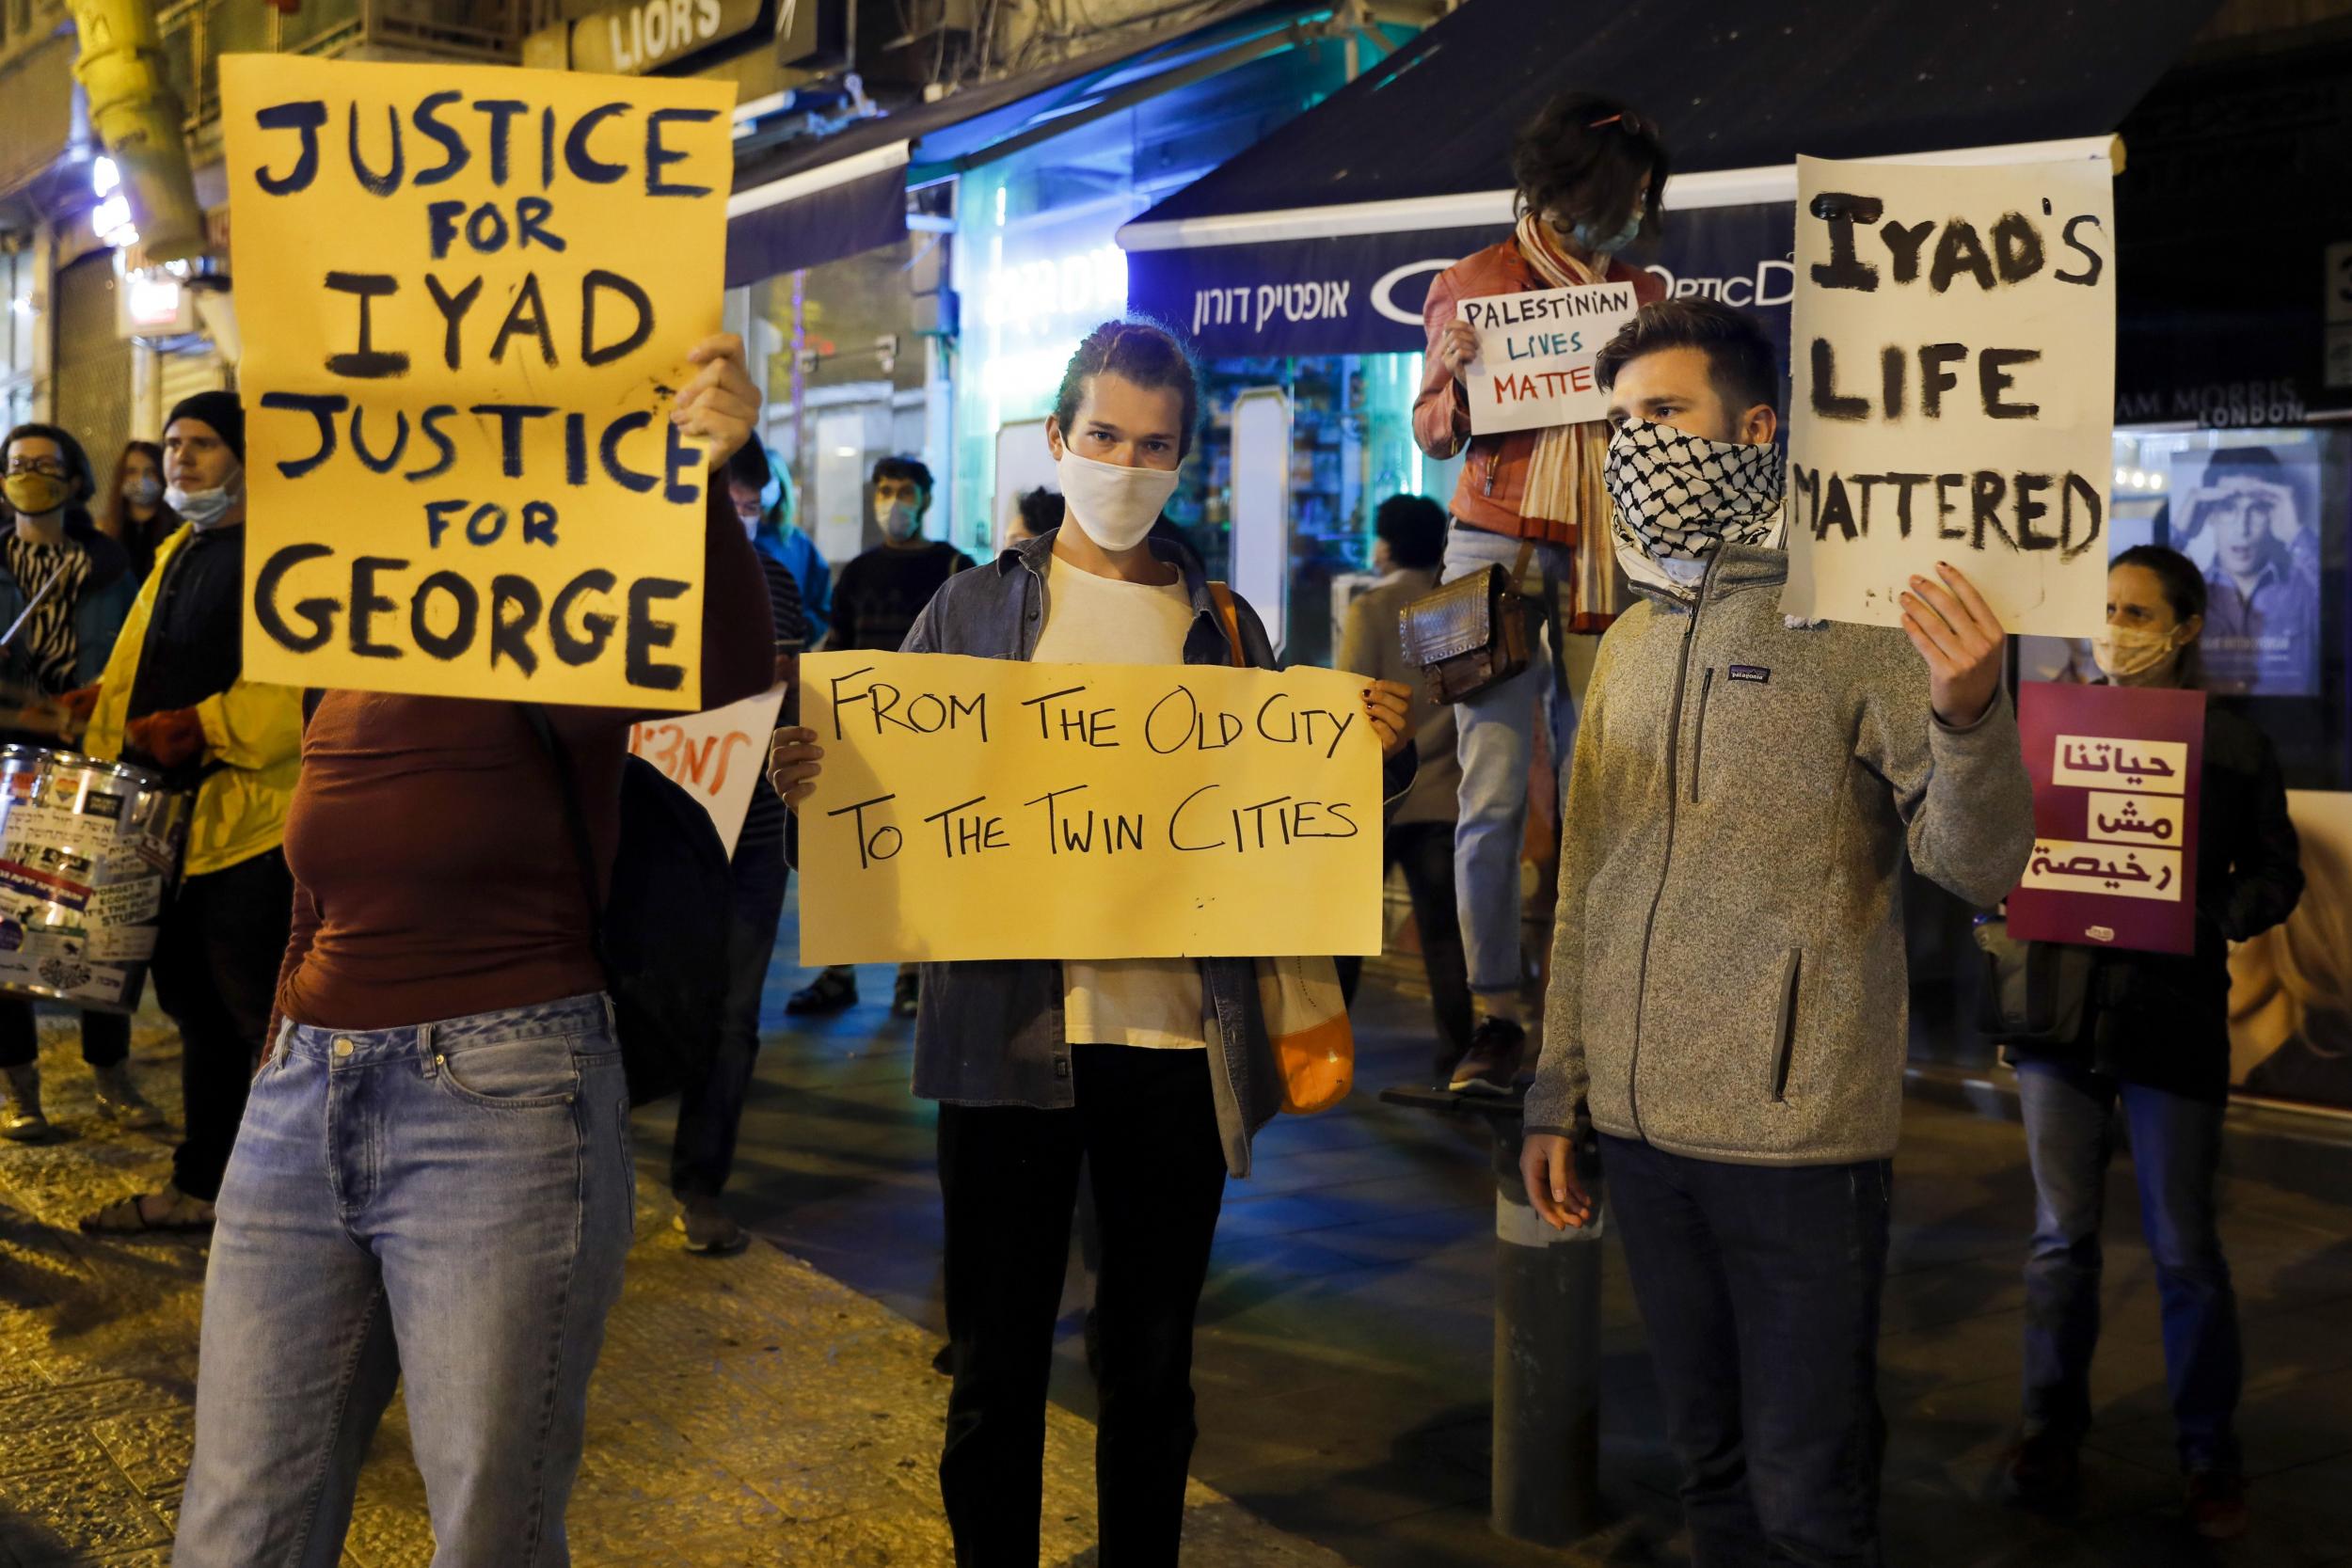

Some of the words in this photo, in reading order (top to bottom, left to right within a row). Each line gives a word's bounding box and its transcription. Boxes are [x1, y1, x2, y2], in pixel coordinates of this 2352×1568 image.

[255, 89, 722, 198] JUSTICE
[427, 196, 566, 259] FOR
[1810, 192, 2104, 293] IYAD'S
[326, 270, 654, 378] IYAD
[1193, 287, 1250, 336] דורון
[1255, 280, 1349, 333] אופטיק
[1507, 332, 1583, 360] LIVES
[1811, 337, 2042, 421] LIFE
[2199, 404, 2305, 428] LONDON
[260, 392, 707, 505] JUSTICE
[425, 499, 559, 547] FOR
[1790, 468, 2104, 564] MATTERED
[254, 543, 691, 691] GEORGE
[1732, 672, 1763, 680] patagonia
[831, 667, 988, 742] FROM
[1022, 686, 1120, 748] THE
[1145, 685, 1243, 753] OLD
[1257, 693, 1355, 758] CITY
[2063, 742, 2175, 785] حياتنا
[828, 793, 903, 869] TO
[924, 796, 1010, 858] THE
[1025, 784, 1144, 854] TWIN
[1168, 784, 1359, 854] CITIES
[2097, 800, 2173, 839] مش
[2031, 845, 2173, 892] رخيصة
